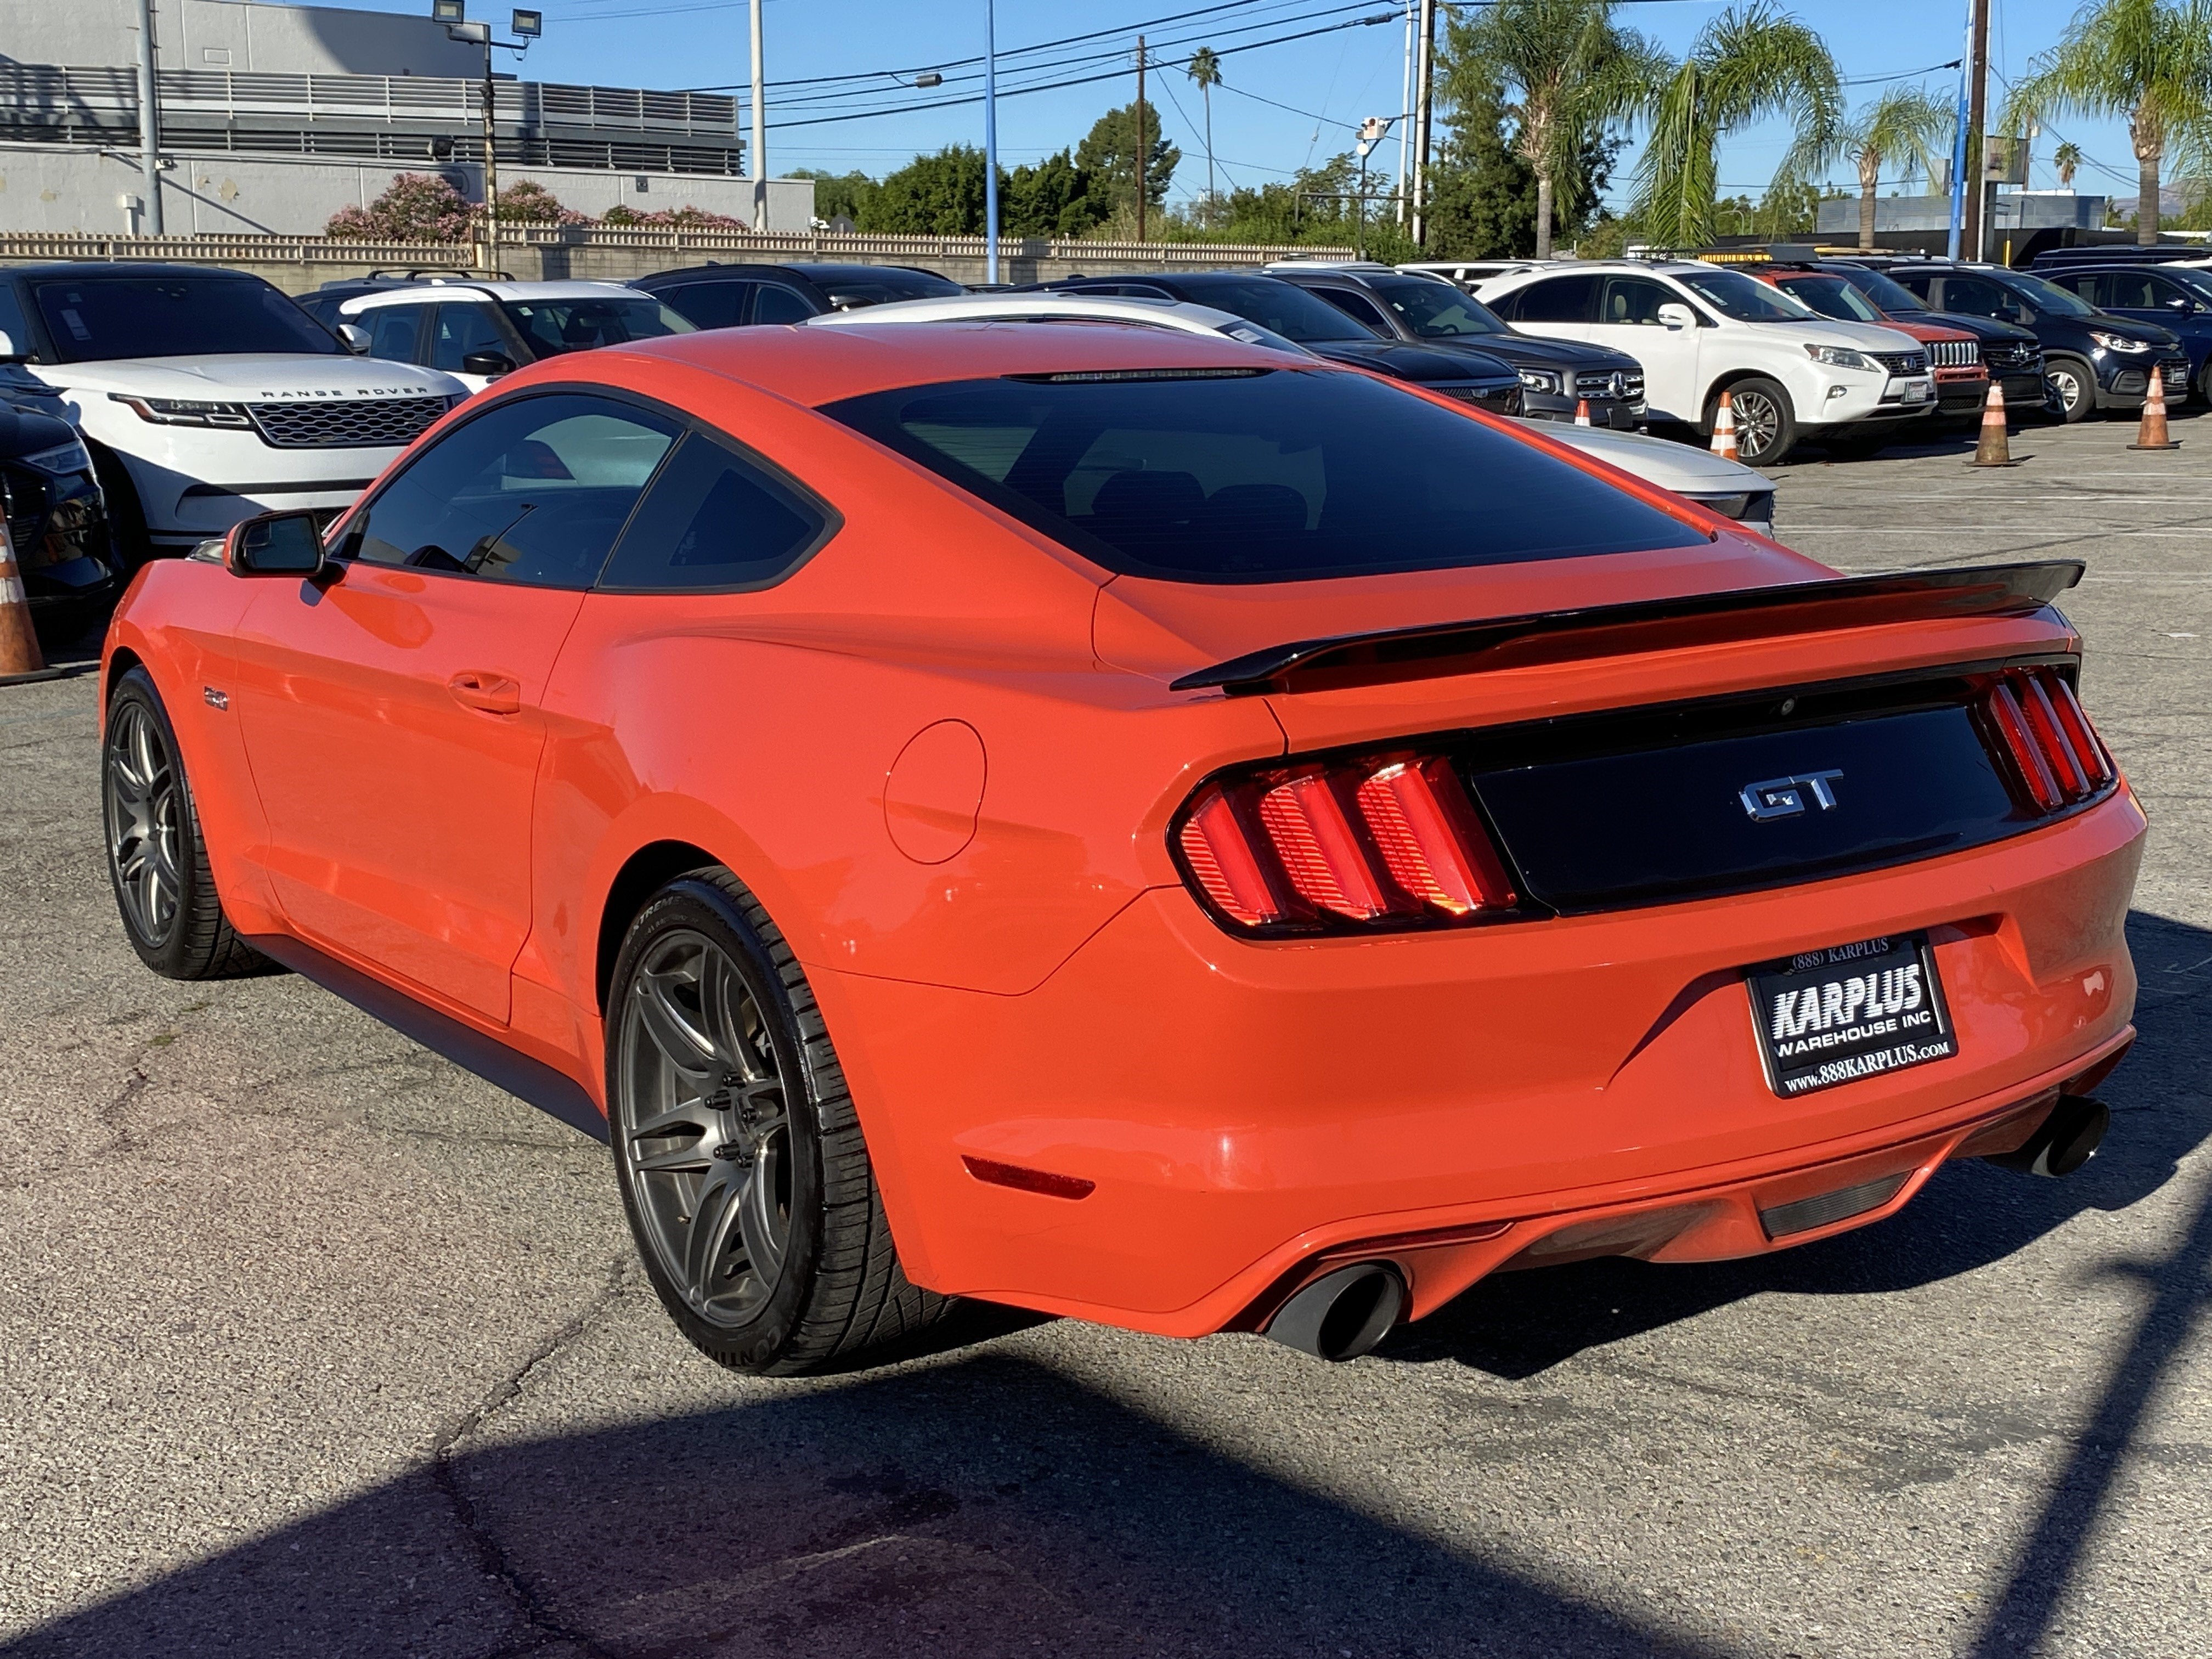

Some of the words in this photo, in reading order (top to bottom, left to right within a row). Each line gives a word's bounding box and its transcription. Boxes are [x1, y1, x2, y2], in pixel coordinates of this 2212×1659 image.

[357, 387, 428, 396] ROVER
[1738, 768, 1844, 823] GT
[1792, 951, 1824, 970] (888)
[1829, 938, 1889, 962] KARPLUS
[1771, 964, 1921, 1040] KARPLUS
[1773, 1019, 1897, 1057] WAREHOUSE
[1902, 1011, 1931, 1028] INC
